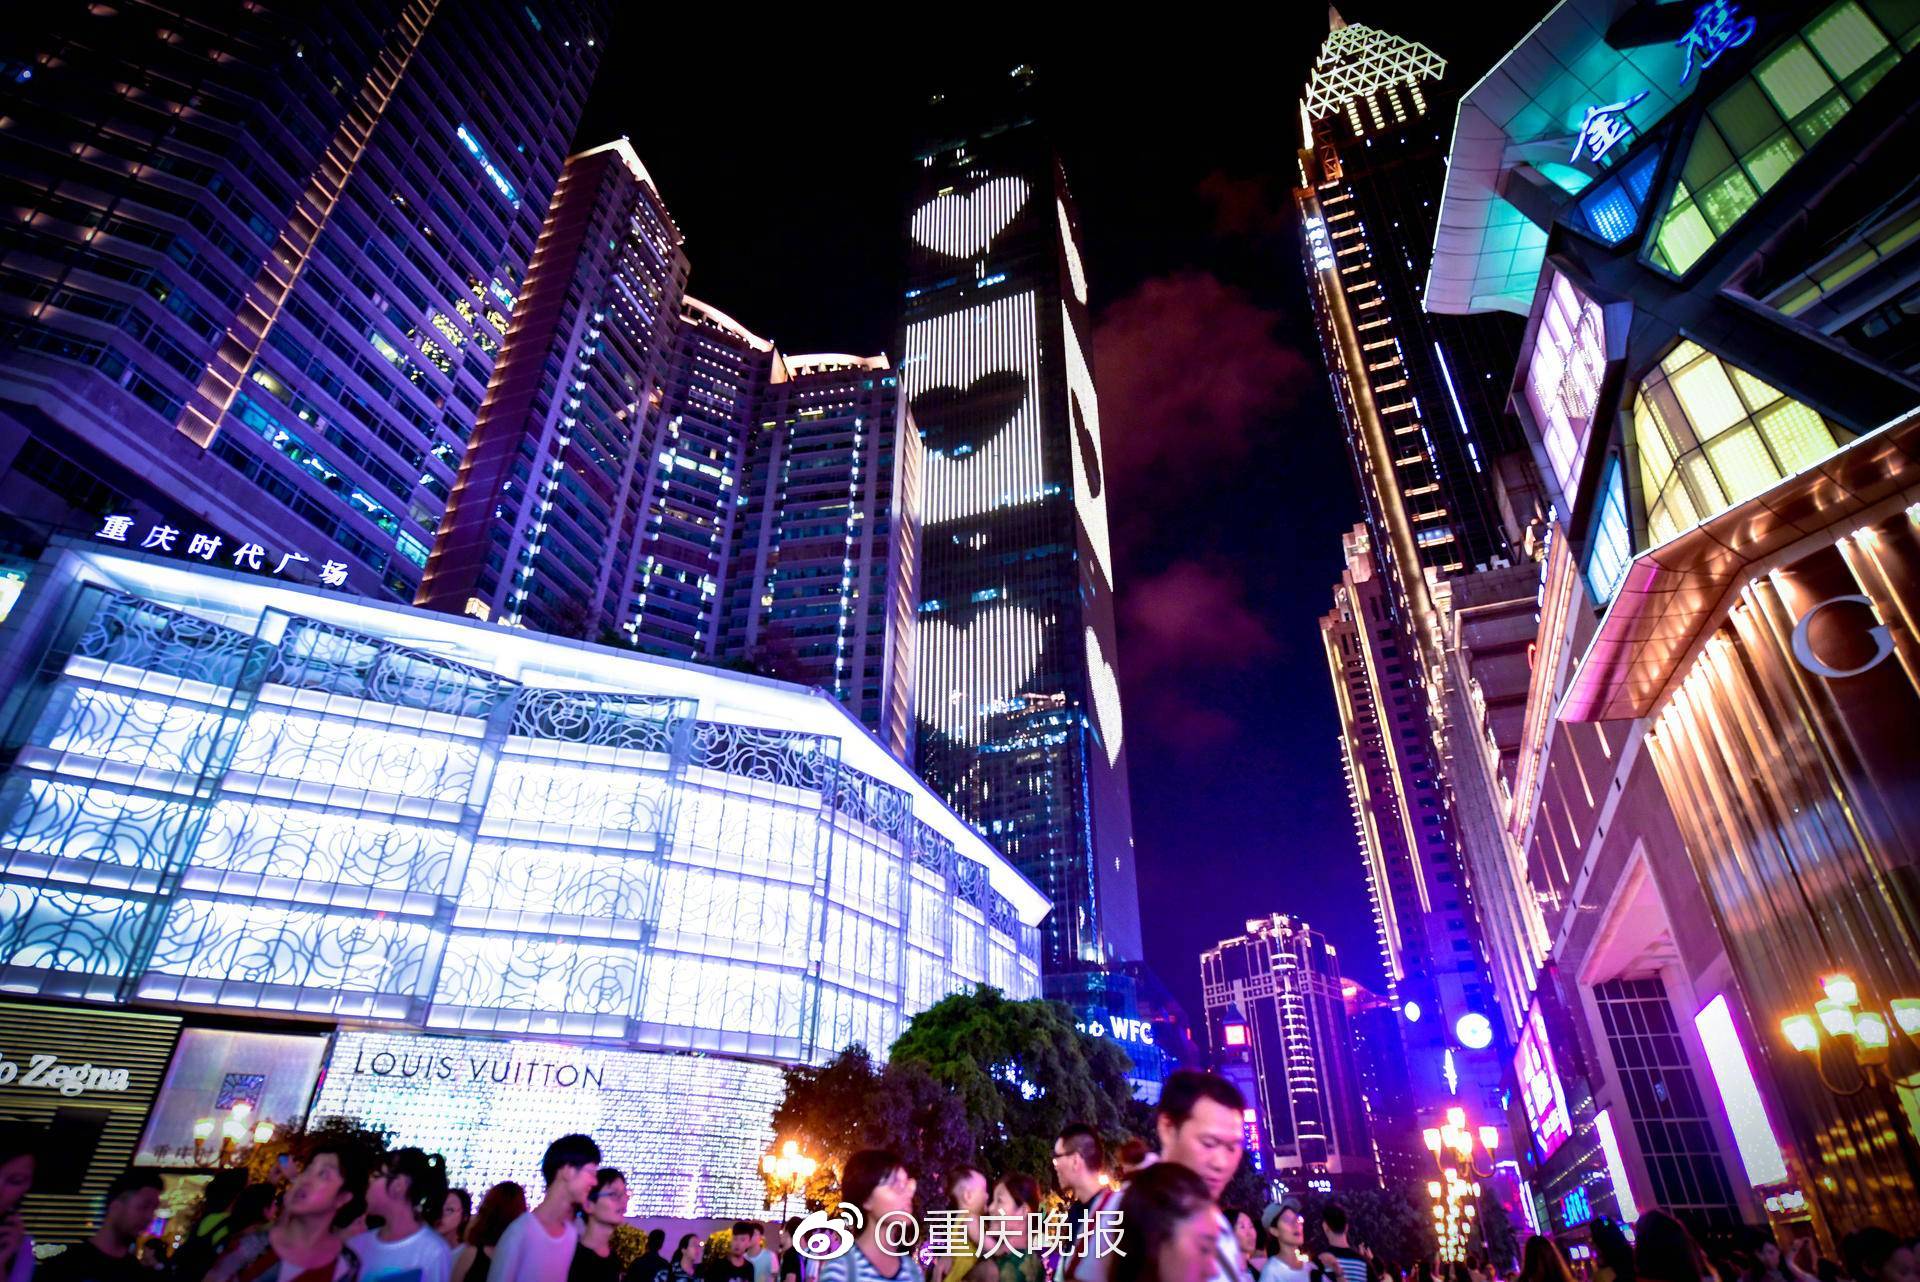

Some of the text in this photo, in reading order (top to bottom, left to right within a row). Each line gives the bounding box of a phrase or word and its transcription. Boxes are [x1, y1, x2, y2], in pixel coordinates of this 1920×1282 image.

[96, 514, 350, 587] 重庆时代广场
[1109, 1015, 1154, 1045] WFC
[19, 1054, 130, 1097] Zegna
[354, 1050, 604, 1089] LOUIS VUITTON
